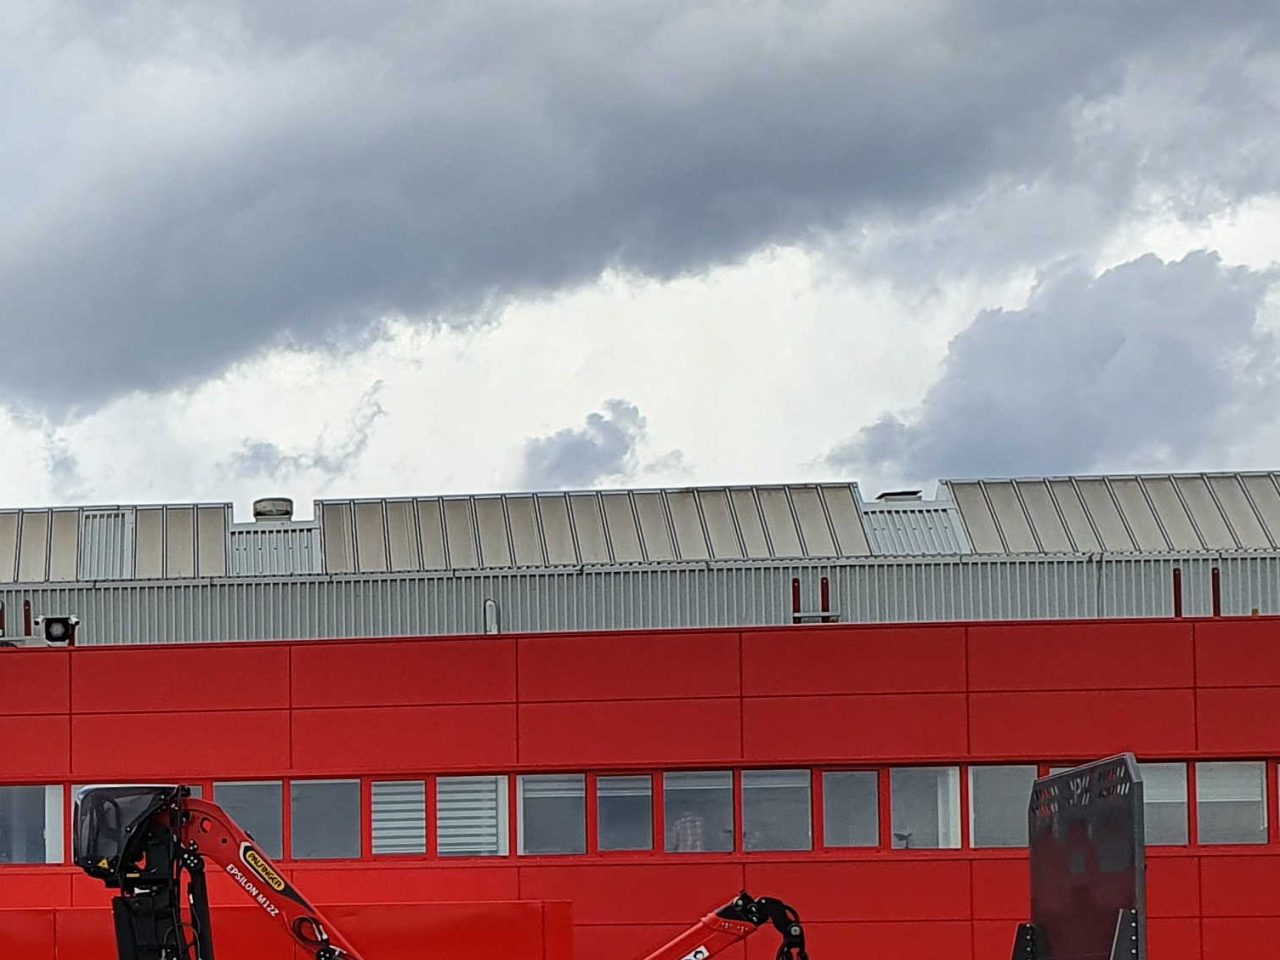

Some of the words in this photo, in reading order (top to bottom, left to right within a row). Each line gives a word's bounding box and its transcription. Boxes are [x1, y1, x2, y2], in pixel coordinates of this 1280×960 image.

[226, 864, 259, 896] EPSILON
[256, 894, 279, 917] M12Z
[247, 852, 282, 888] PALFINGER
